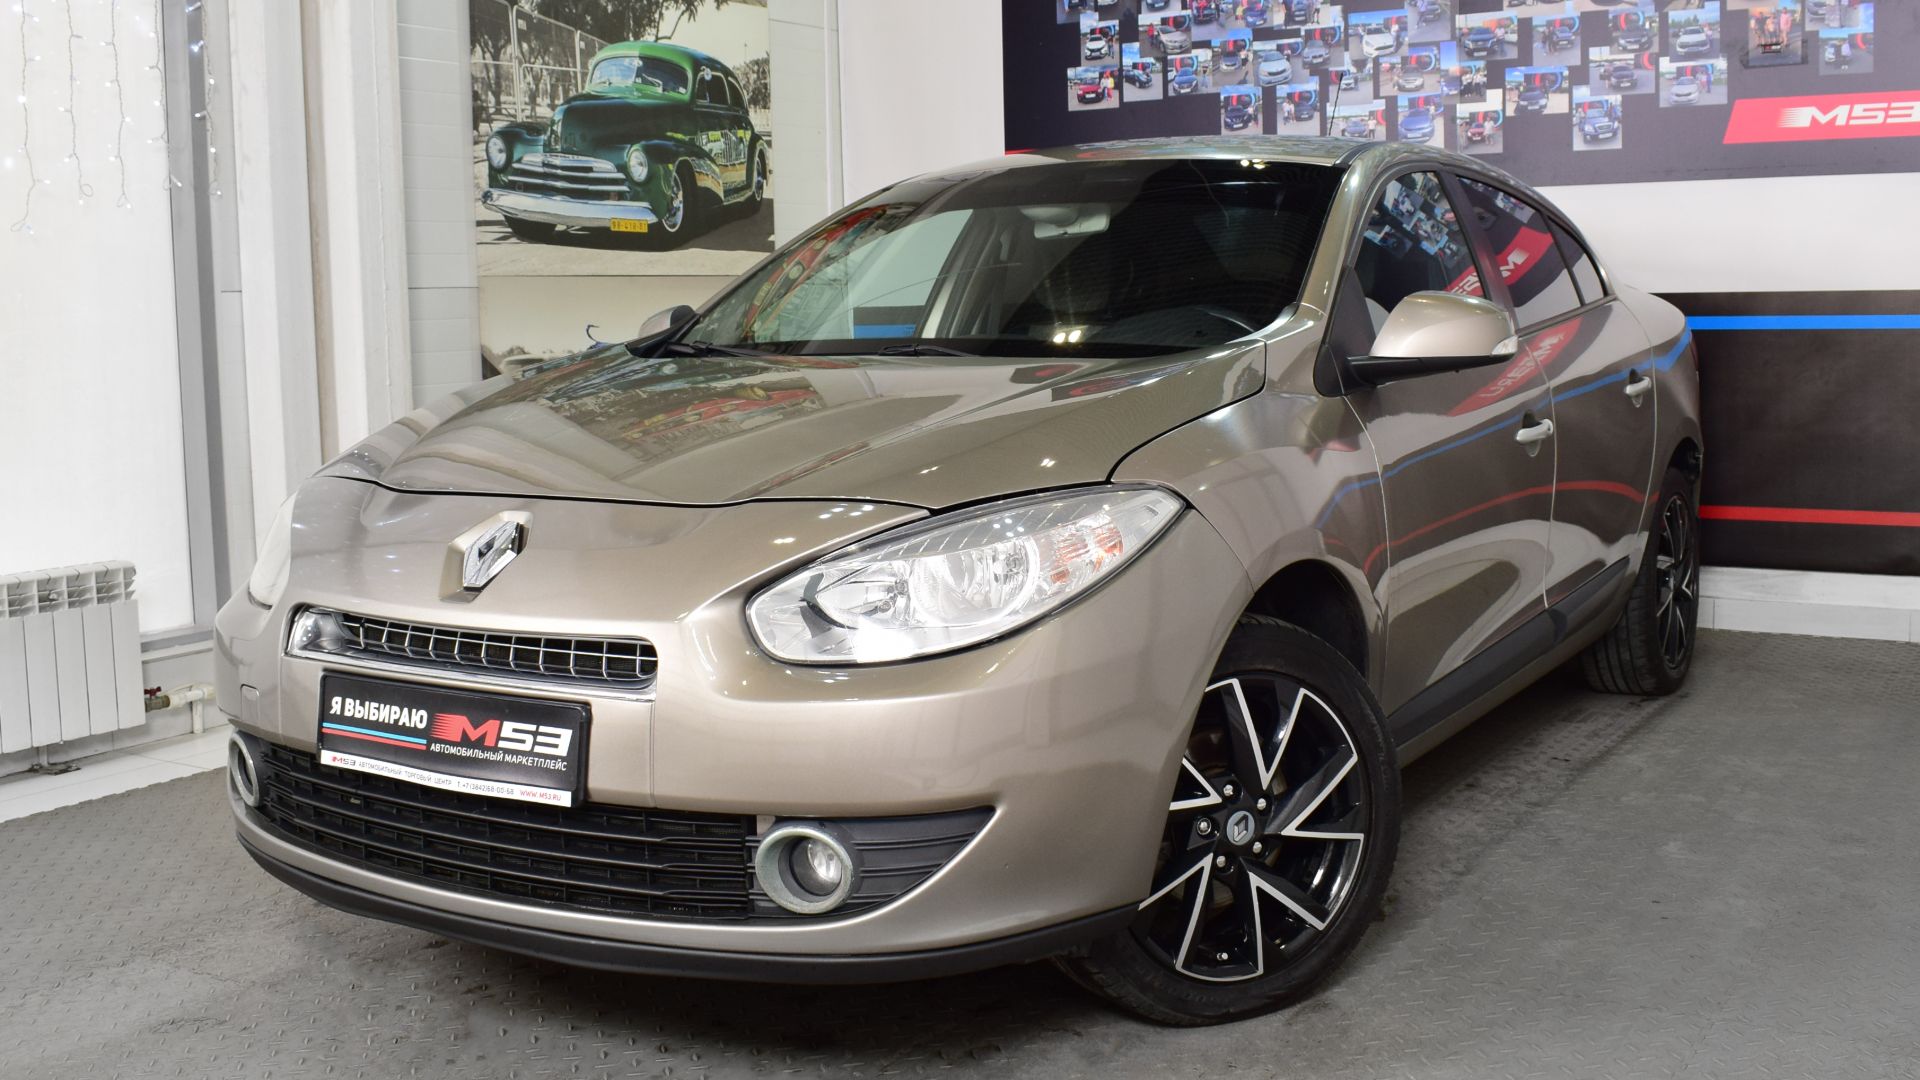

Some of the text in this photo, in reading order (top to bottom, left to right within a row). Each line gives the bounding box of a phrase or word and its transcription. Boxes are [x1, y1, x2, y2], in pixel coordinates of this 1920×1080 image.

[329, 696, 428, 729] Я ВЫБИРАЮ
[431, 713, 573, 757] M53
[358, 761, 402, 775] АВТОМОБИЛЬНЫЙ
[430, 742, 567, 771] АВТОМОБИЛЬНЫЙ МАРКЕТПЛЕЙС
